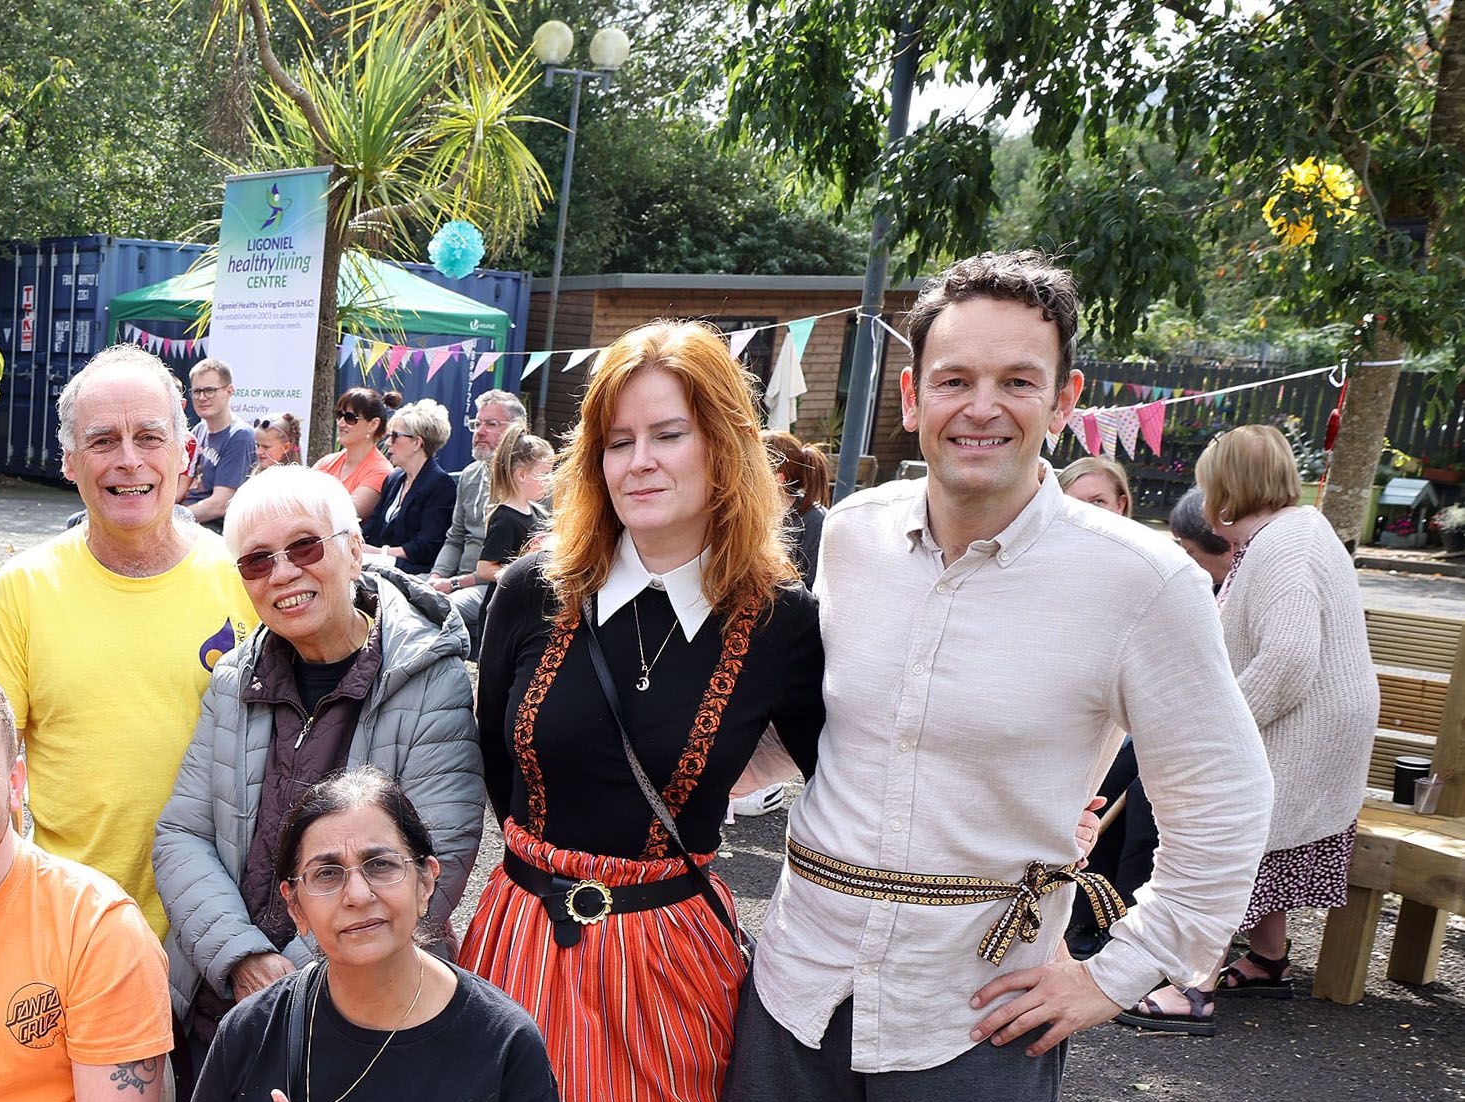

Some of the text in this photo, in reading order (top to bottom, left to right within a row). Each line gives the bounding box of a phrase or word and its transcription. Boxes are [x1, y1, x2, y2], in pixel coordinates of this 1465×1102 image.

[247, 236, 294, 252] LIGONIEL
[246, 275, 288, 289] CENTRE
[251, 389, 262, 398] OF
[262, 389, 285, 398] WORK
[242, 403, 270, 414] Activity
[6, 989, 61, 1027] SANTA
[19, 1009, 61, 1045] CRUZ
[110, 1069, 145, 1095] Ryan
